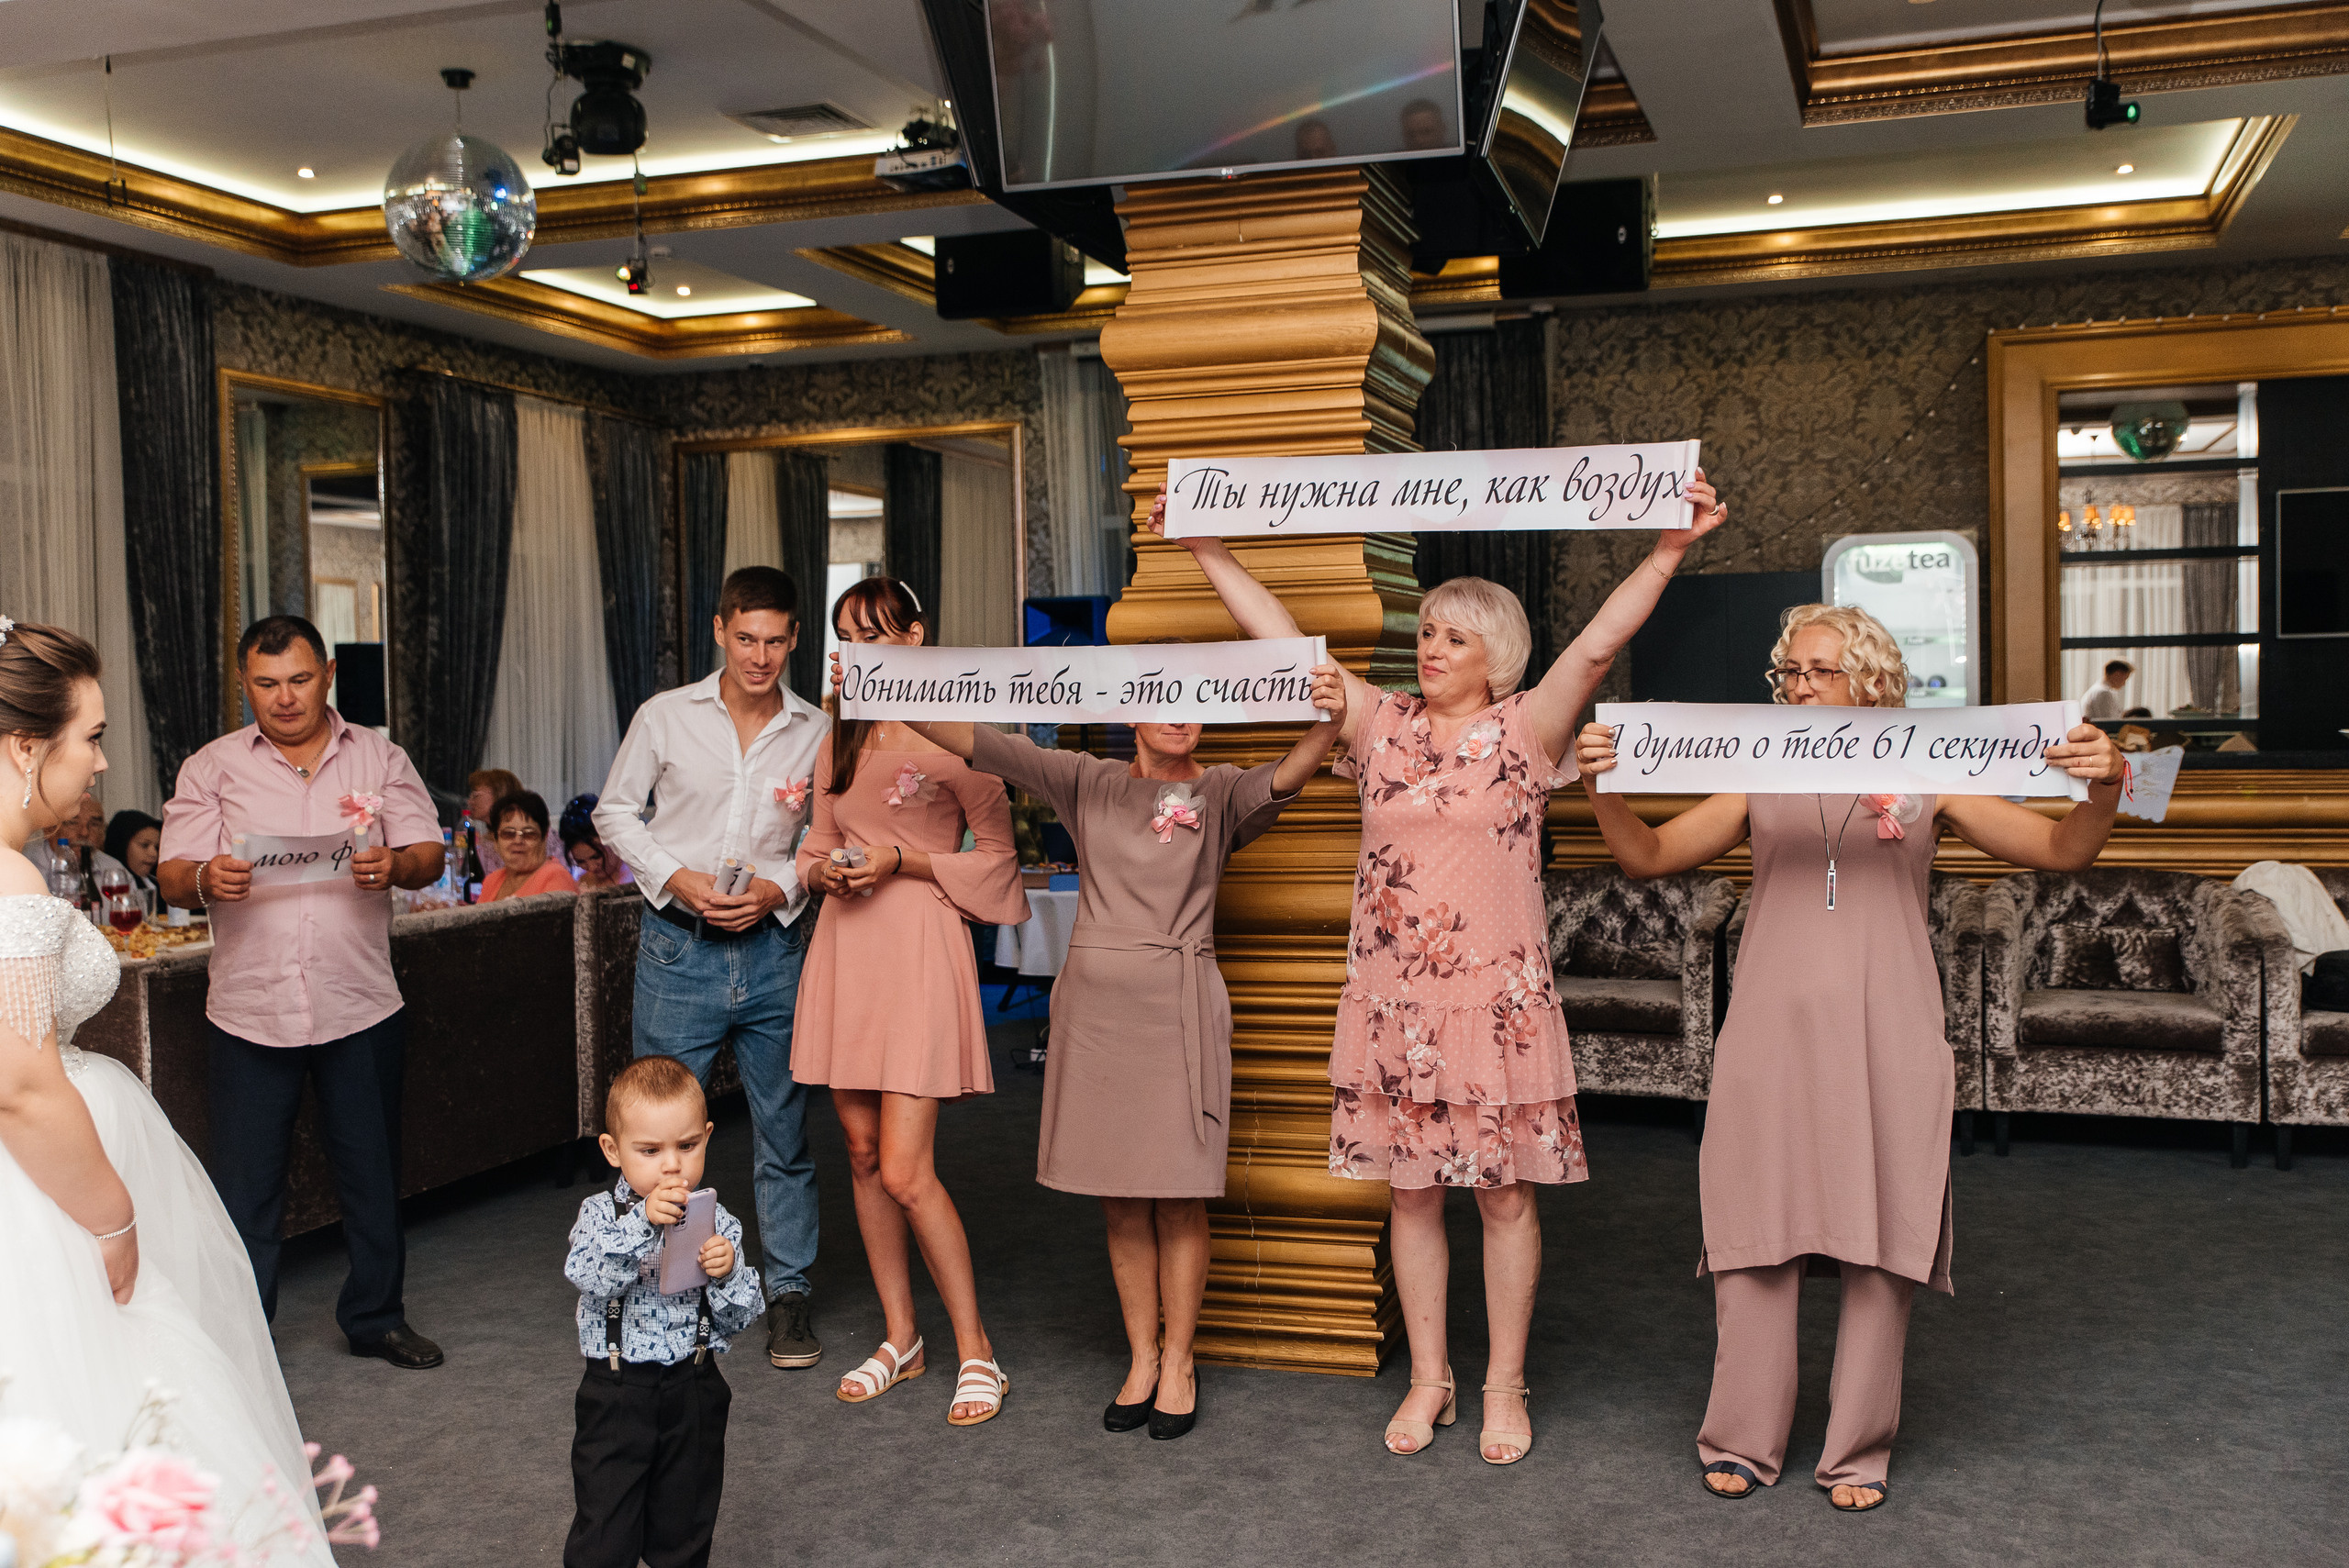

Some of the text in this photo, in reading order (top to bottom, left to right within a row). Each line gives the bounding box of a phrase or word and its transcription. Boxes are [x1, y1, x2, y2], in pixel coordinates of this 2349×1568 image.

[1174, 453, 1687, 528] Ты нужна мне, как воздух
[841, 661, 997, 704] Обнимать
[1008, 664, 1083, 706] тебя
[1119, 666, 1183, 705] это
[1196, 662, 1314, 703] счасть
[1633, 722, 1741, 775] думаю
[1753, 737, 1770, 759] о
[1781, 721, 1860, 760] тебе
[1873, 724, 1917, 760] 61
[253, 851, 320, 868] мою
